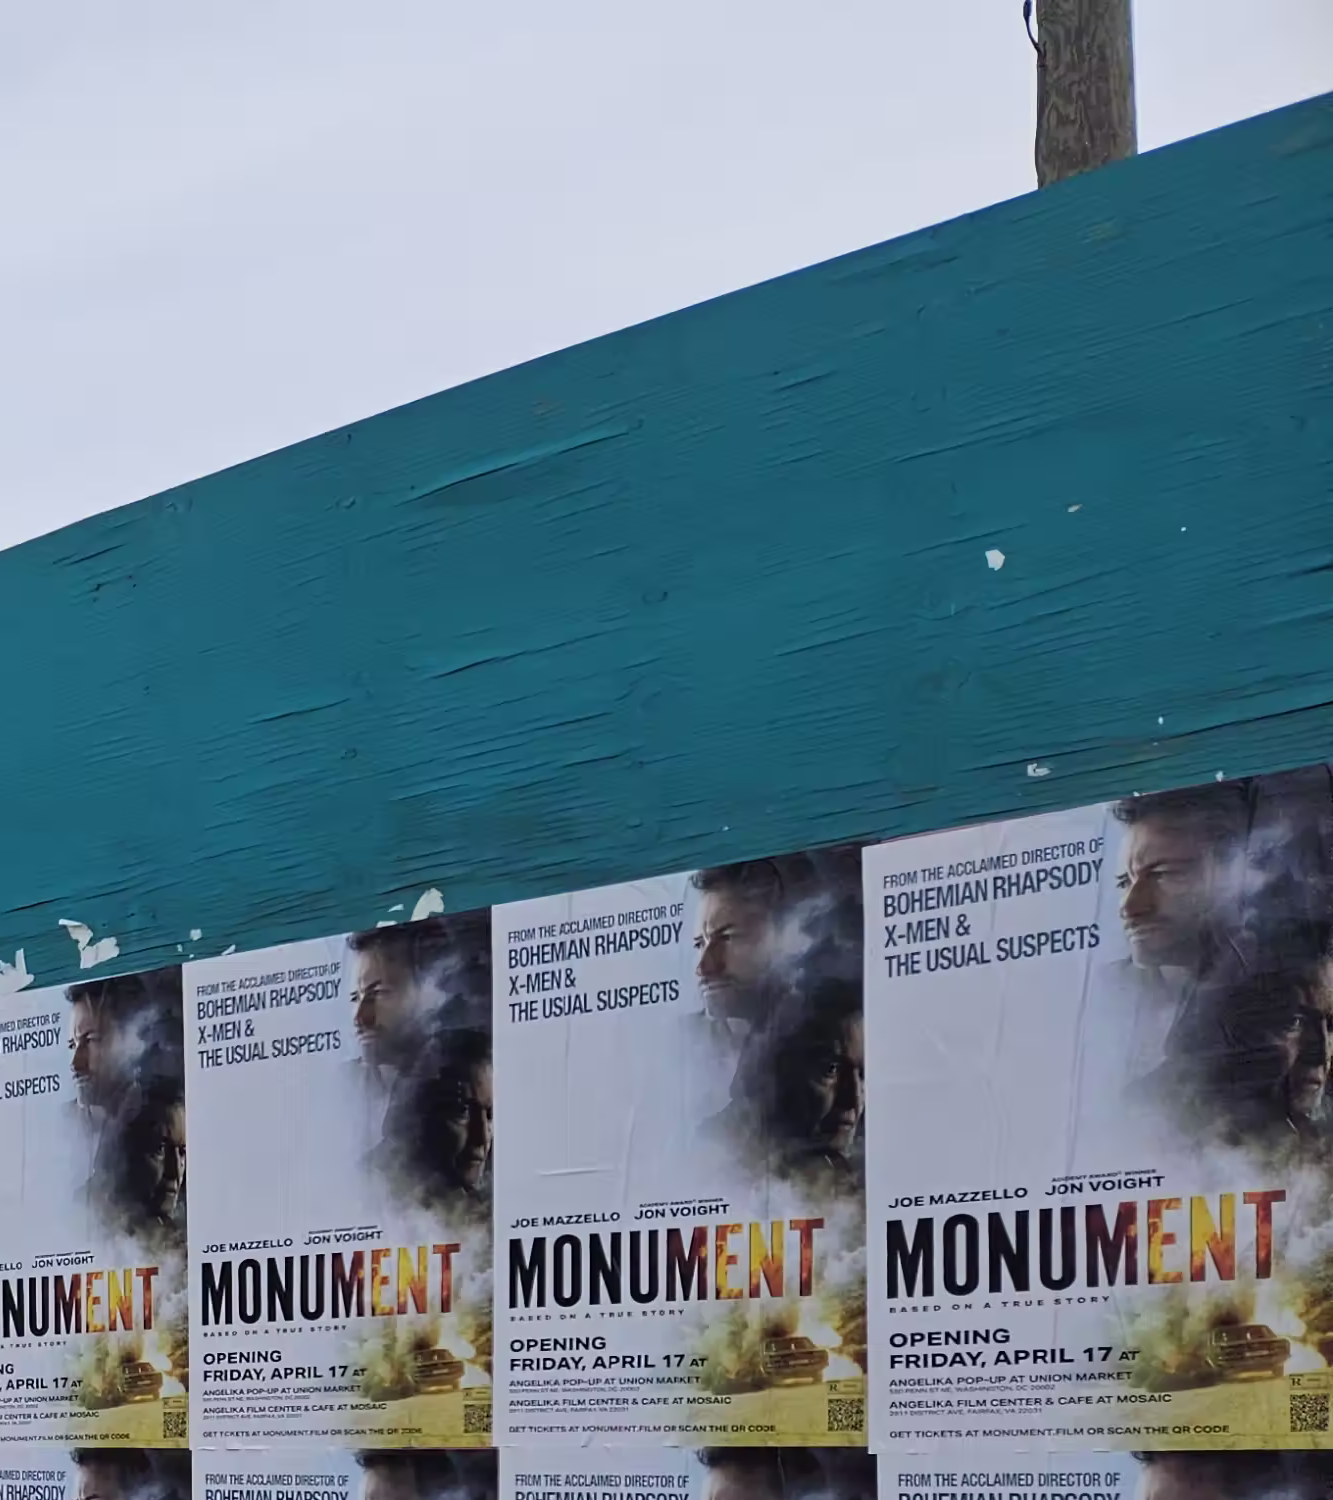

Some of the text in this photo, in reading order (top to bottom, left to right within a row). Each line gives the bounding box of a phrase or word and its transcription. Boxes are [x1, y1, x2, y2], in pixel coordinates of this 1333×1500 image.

[883, 858, 1106, 918] BOHEMIAN RHAPSODY
[884, 923, 1101, 978] THE USUAL SUSPECTS
[197, 978, 343, 1020] BOHEMIAN RHAPSODY
[509, 1203, 728, 1229] JOE MAZZELLO JON VOIGHT
[886, 1190, 1286, 1300] MONUMENT
[509, 1219, 824, 1309] MONUMENT
[201, 1244, 461, 1326] MONUMENT
[510, 1335, 605, 1353] OPENING
[890, 1327, 1010, 1349] OPENING
[203, 1349, 281, 1366] OPENING
[510, 1354, 707, 1374] FRIDAY, APRIL 17 AT
[890, 1347, 1139, 1372] FRIDAY, APRIL 17 AT
[5, 1377, 48, 1391] APRIL
[53, 1377, 68, 1389] 17
[71, 1381, 83, 1389] AT
[203, 1365, 366, 1384] FRIDAY, APRIL 17 AT
[897, 1472, 1120, 1487] FROM THE ACCLAIMED DIRECTOR OF
